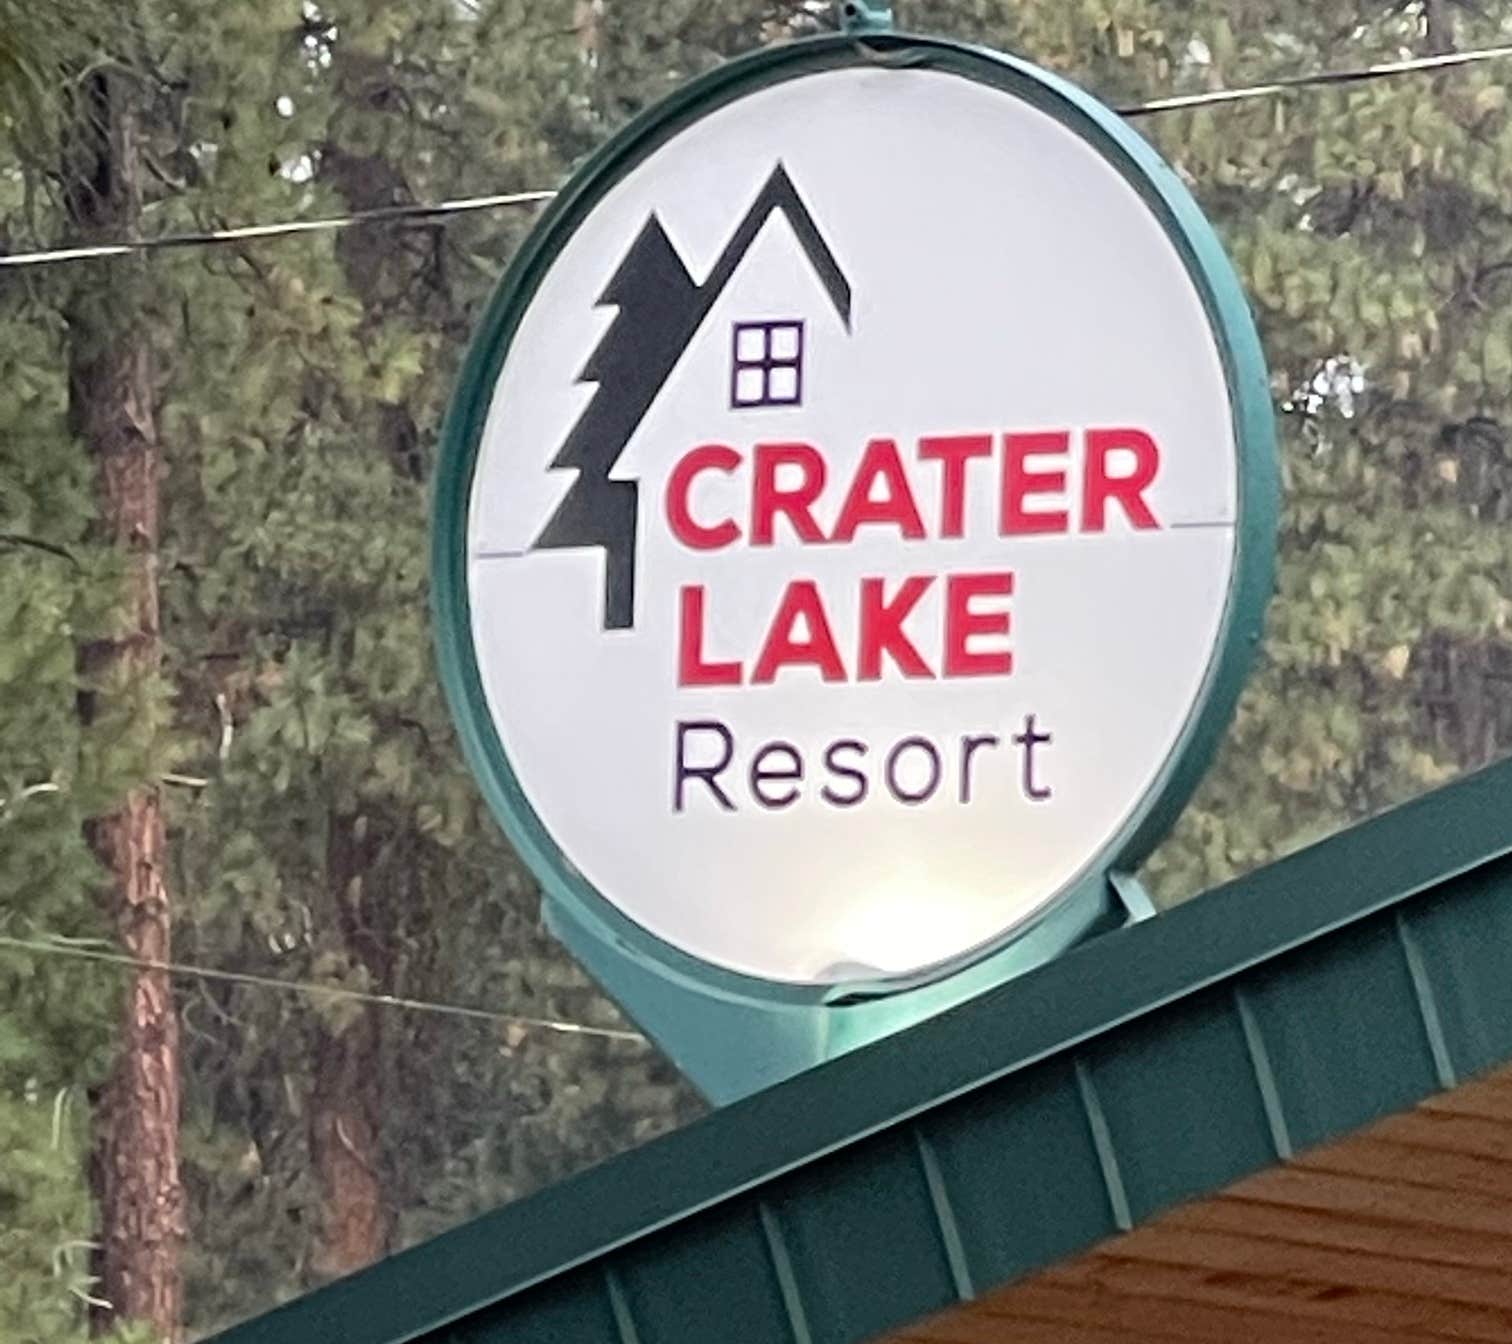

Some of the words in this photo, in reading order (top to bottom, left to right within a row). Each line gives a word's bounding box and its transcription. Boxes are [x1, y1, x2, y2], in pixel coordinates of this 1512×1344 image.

[665, 429, 1161, 550] CRATER
[677, 572, 1014, 687] LAKE
[673, 714, 1053, 813] Resort
